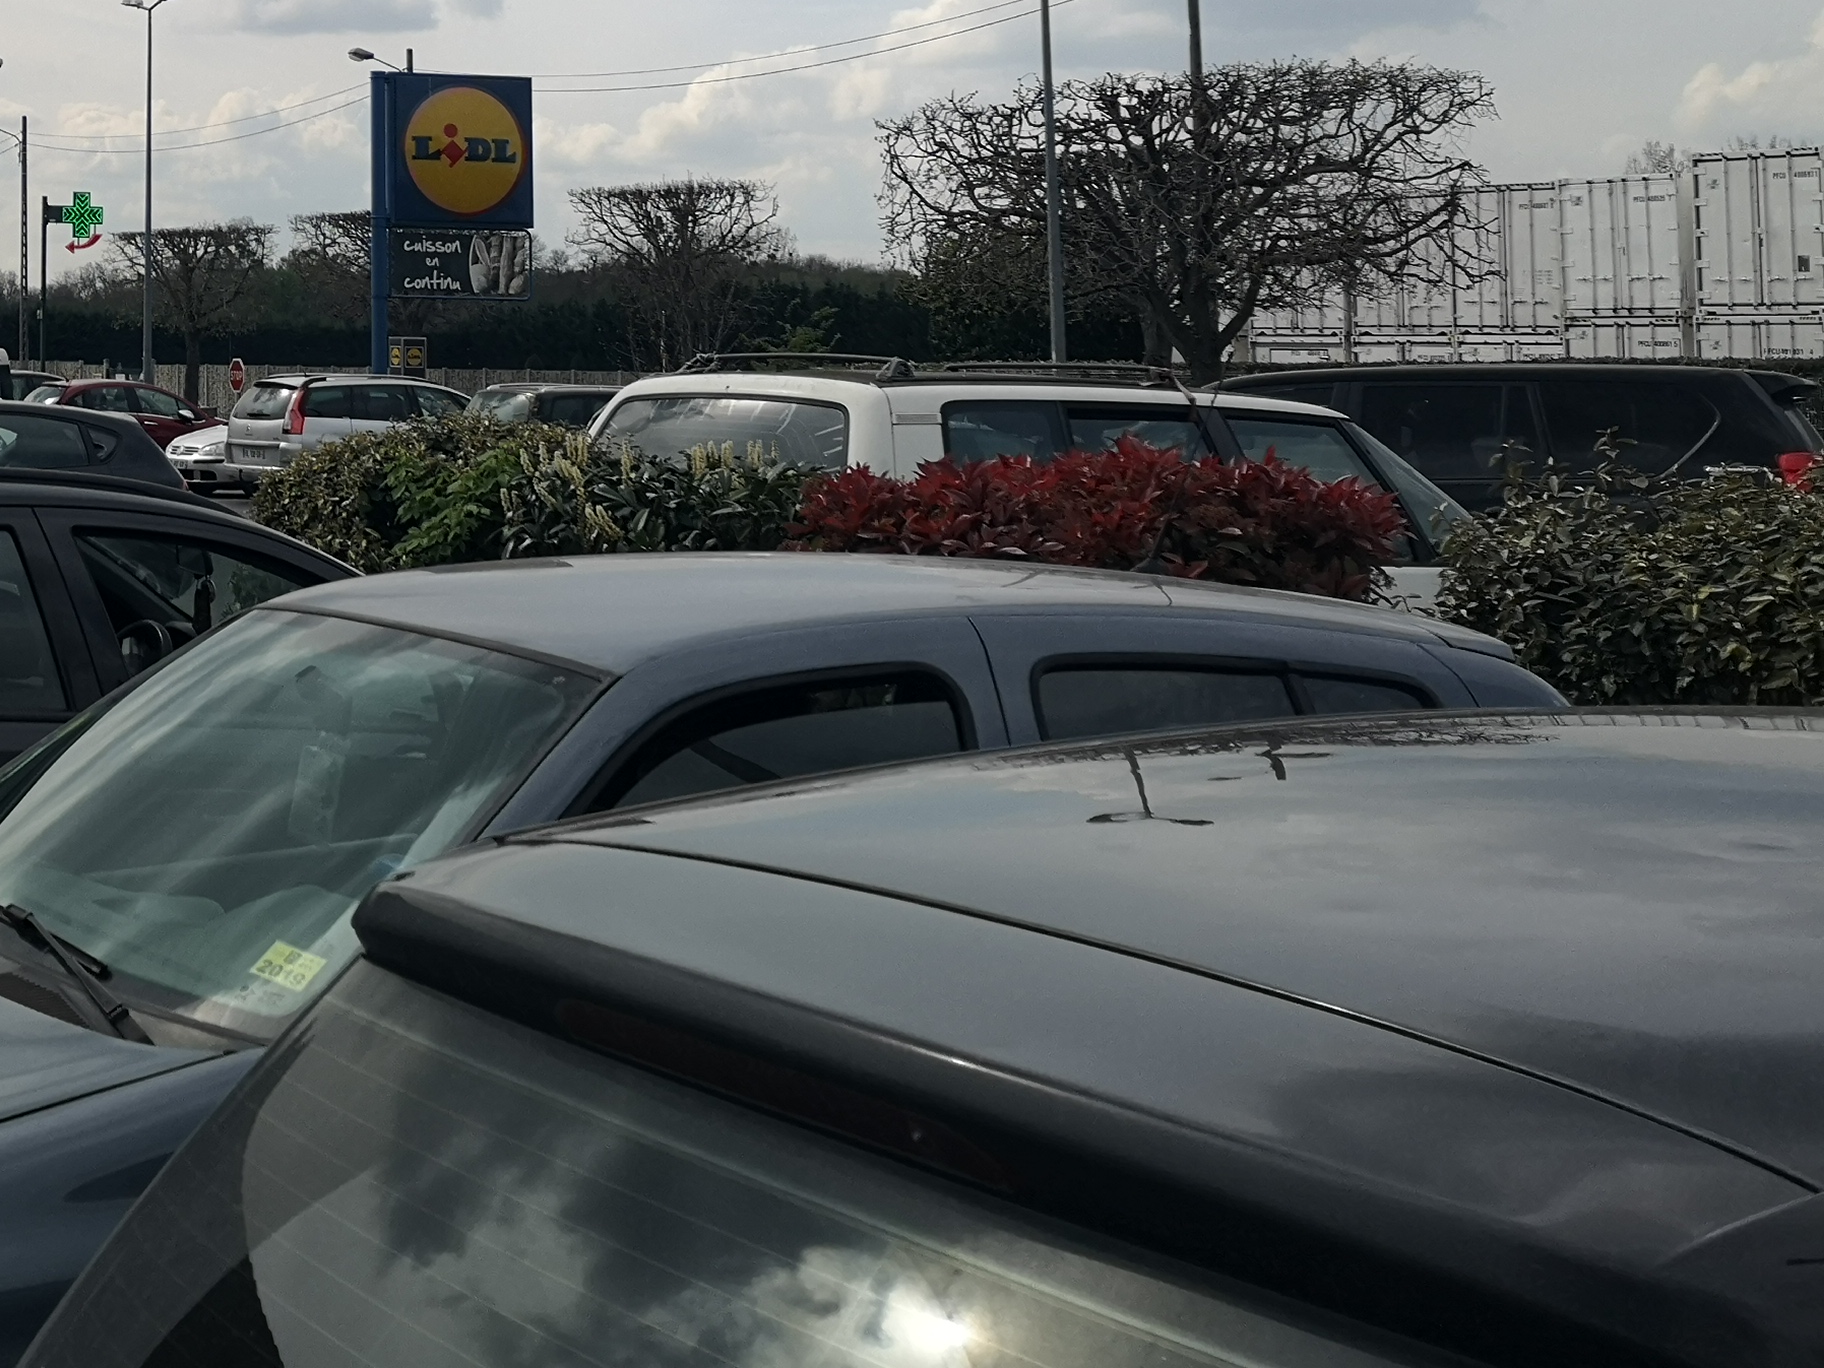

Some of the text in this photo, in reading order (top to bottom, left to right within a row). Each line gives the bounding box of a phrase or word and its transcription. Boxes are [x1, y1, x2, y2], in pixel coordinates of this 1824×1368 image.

[404, 235, 461, 253] cuisson
[426, 256, 439, 267] en
[404, 270, 461, 291] continu
[230, 370, 242, 381] STOP
